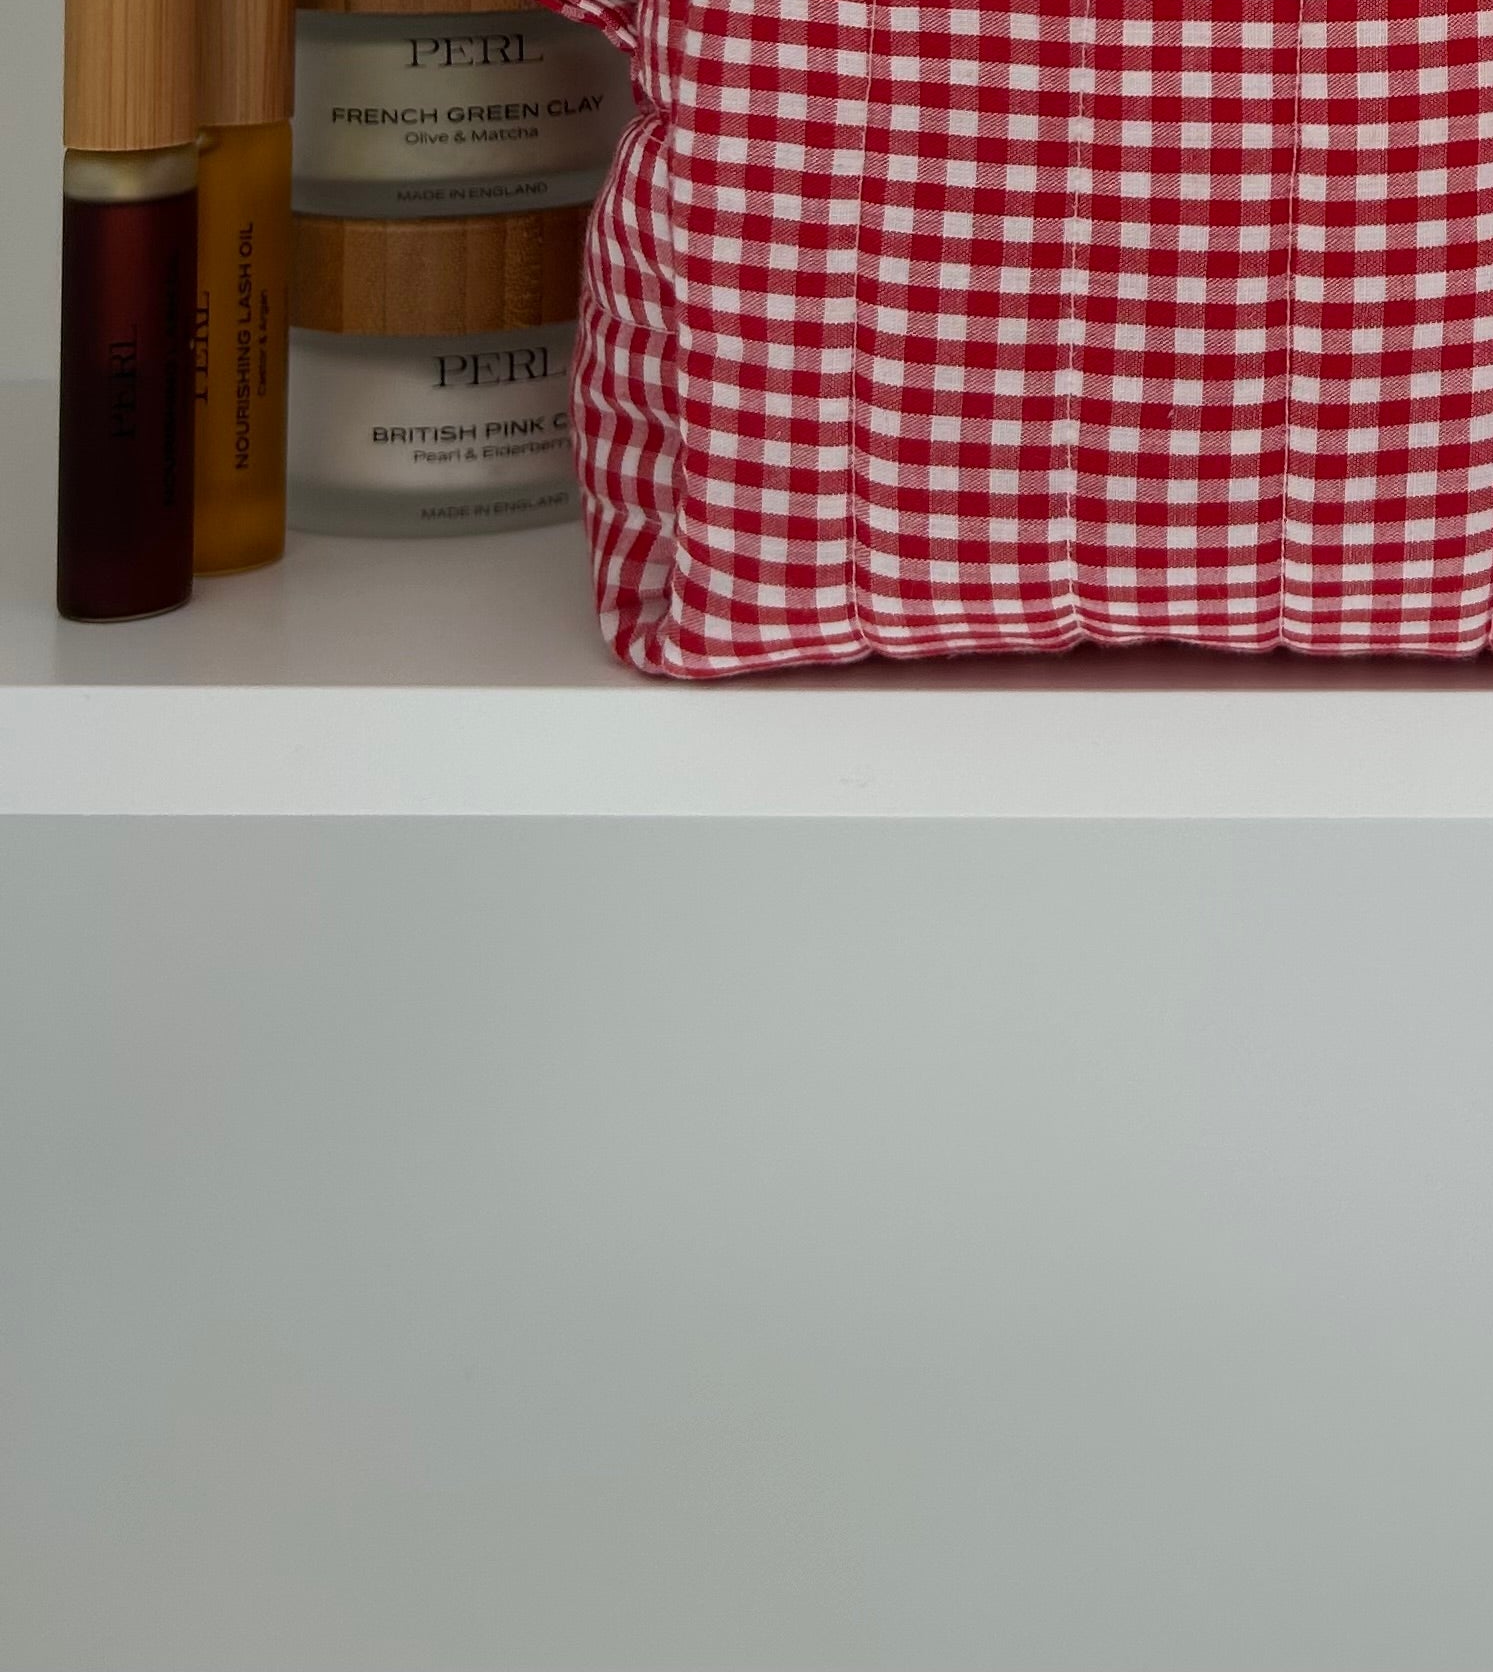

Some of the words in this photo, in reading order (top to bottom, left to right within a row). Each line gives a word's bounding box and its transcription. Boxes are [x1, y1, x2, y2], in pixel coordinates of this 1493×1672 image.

[405, 34, 544, 68] PERL
[332, 106, 438, 125] FRENCH
[447, 102, 540, 122] GREEN
[546, 94, 605, 117] CLAY
[405, 130, 449, 145] Olive
[453, 131, 466, 144] &
[471, 127, 539, 143] Matcha
[397, 183, 445, 201] MADE
[449, 185, 465, 200] IN
[469, 181, 548, 200] ENGLAND
[238, 221, 254, 257] OIL
[237, 263, 253, 324] LASH
[432, 346, 567, 389] PERL
[234, 329, 252, 470] NOURISHING
[373, 425, 477, 444] BRITISH
[486, 416, 545, 439] PINK
[413, 448, 461, 464] Pearl
[464, 448, 477, 462] &
